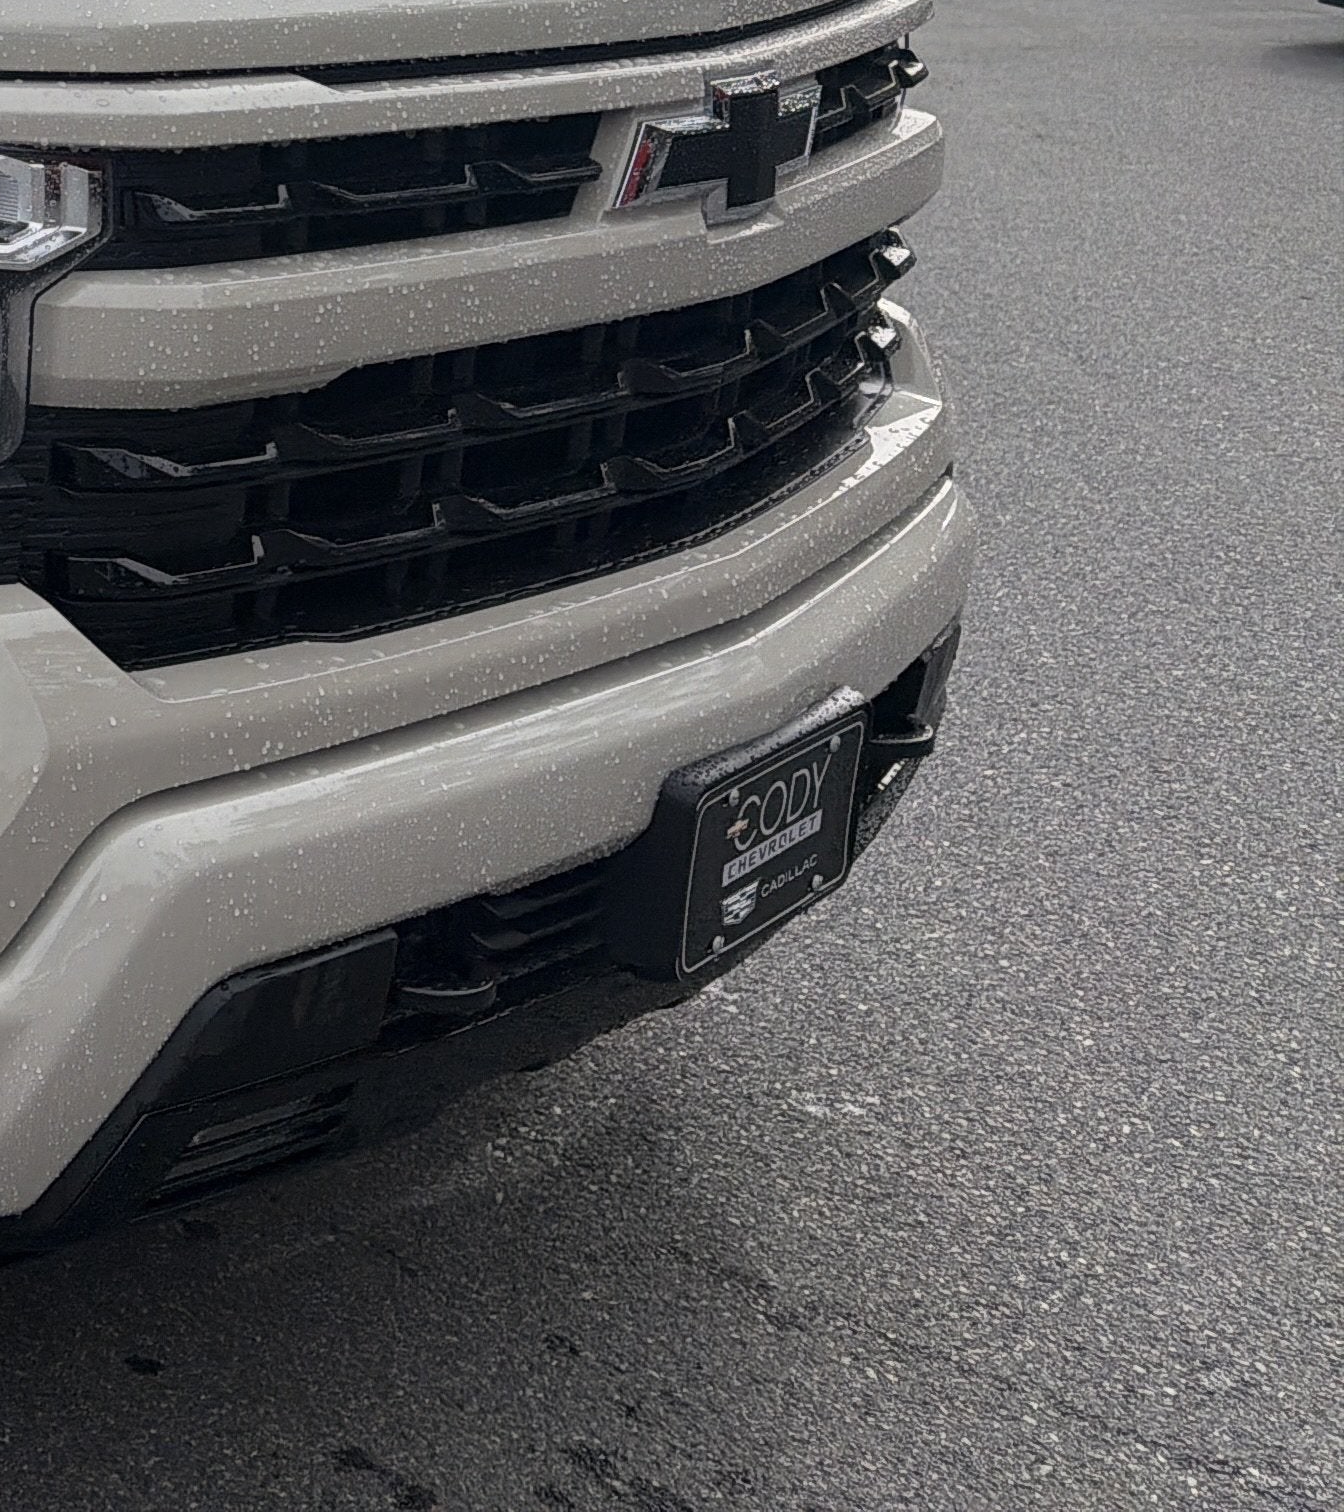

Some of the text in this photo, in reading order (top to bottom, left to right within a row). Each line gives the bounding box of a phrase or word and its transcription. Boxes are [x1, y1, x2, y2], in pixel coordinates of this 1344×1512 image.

[733, 753, 832, 851] CODY
[726, 816, 818, 880] CHEVROLET
[760, 852, 819, 898] CADILLAC
